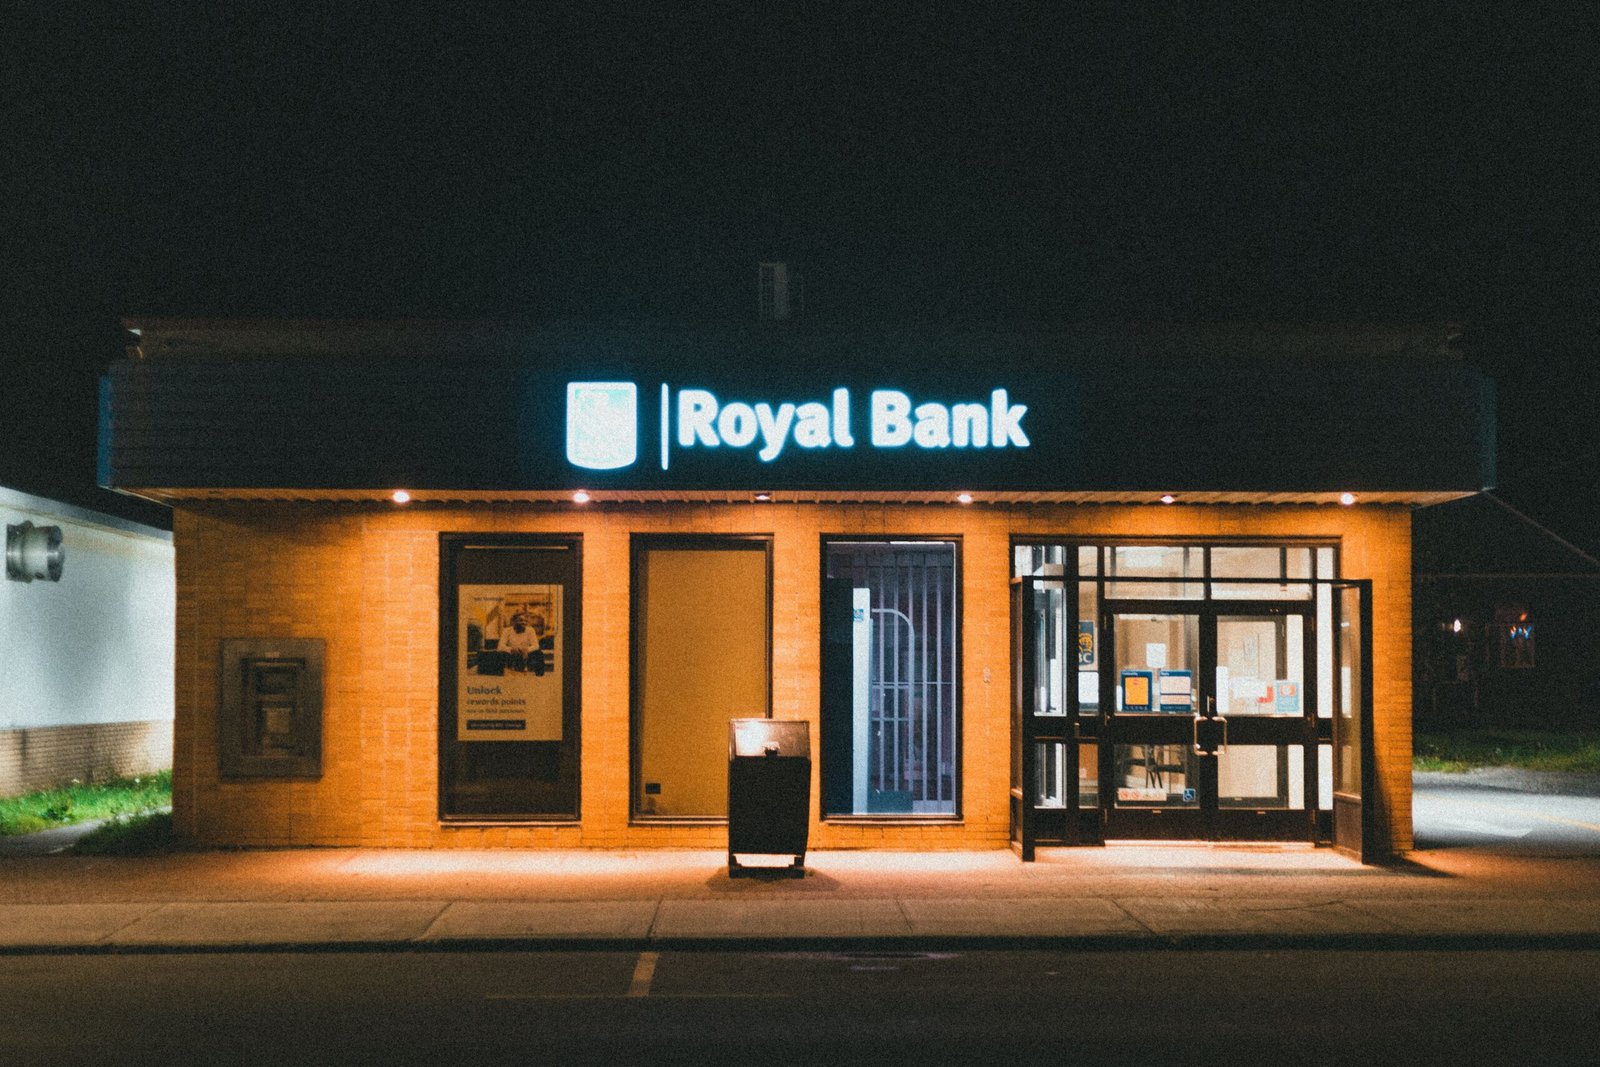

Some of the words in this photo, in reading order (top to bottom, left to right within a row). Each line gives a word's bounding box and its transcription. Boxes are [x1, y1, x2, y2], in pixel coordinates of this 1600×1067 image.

[678, 387, 854, 462] Royal
[871, 388, 1030, 448] Bank
[467, 685, 502, 695] Unlock
[501, 697, 526, 707] points
